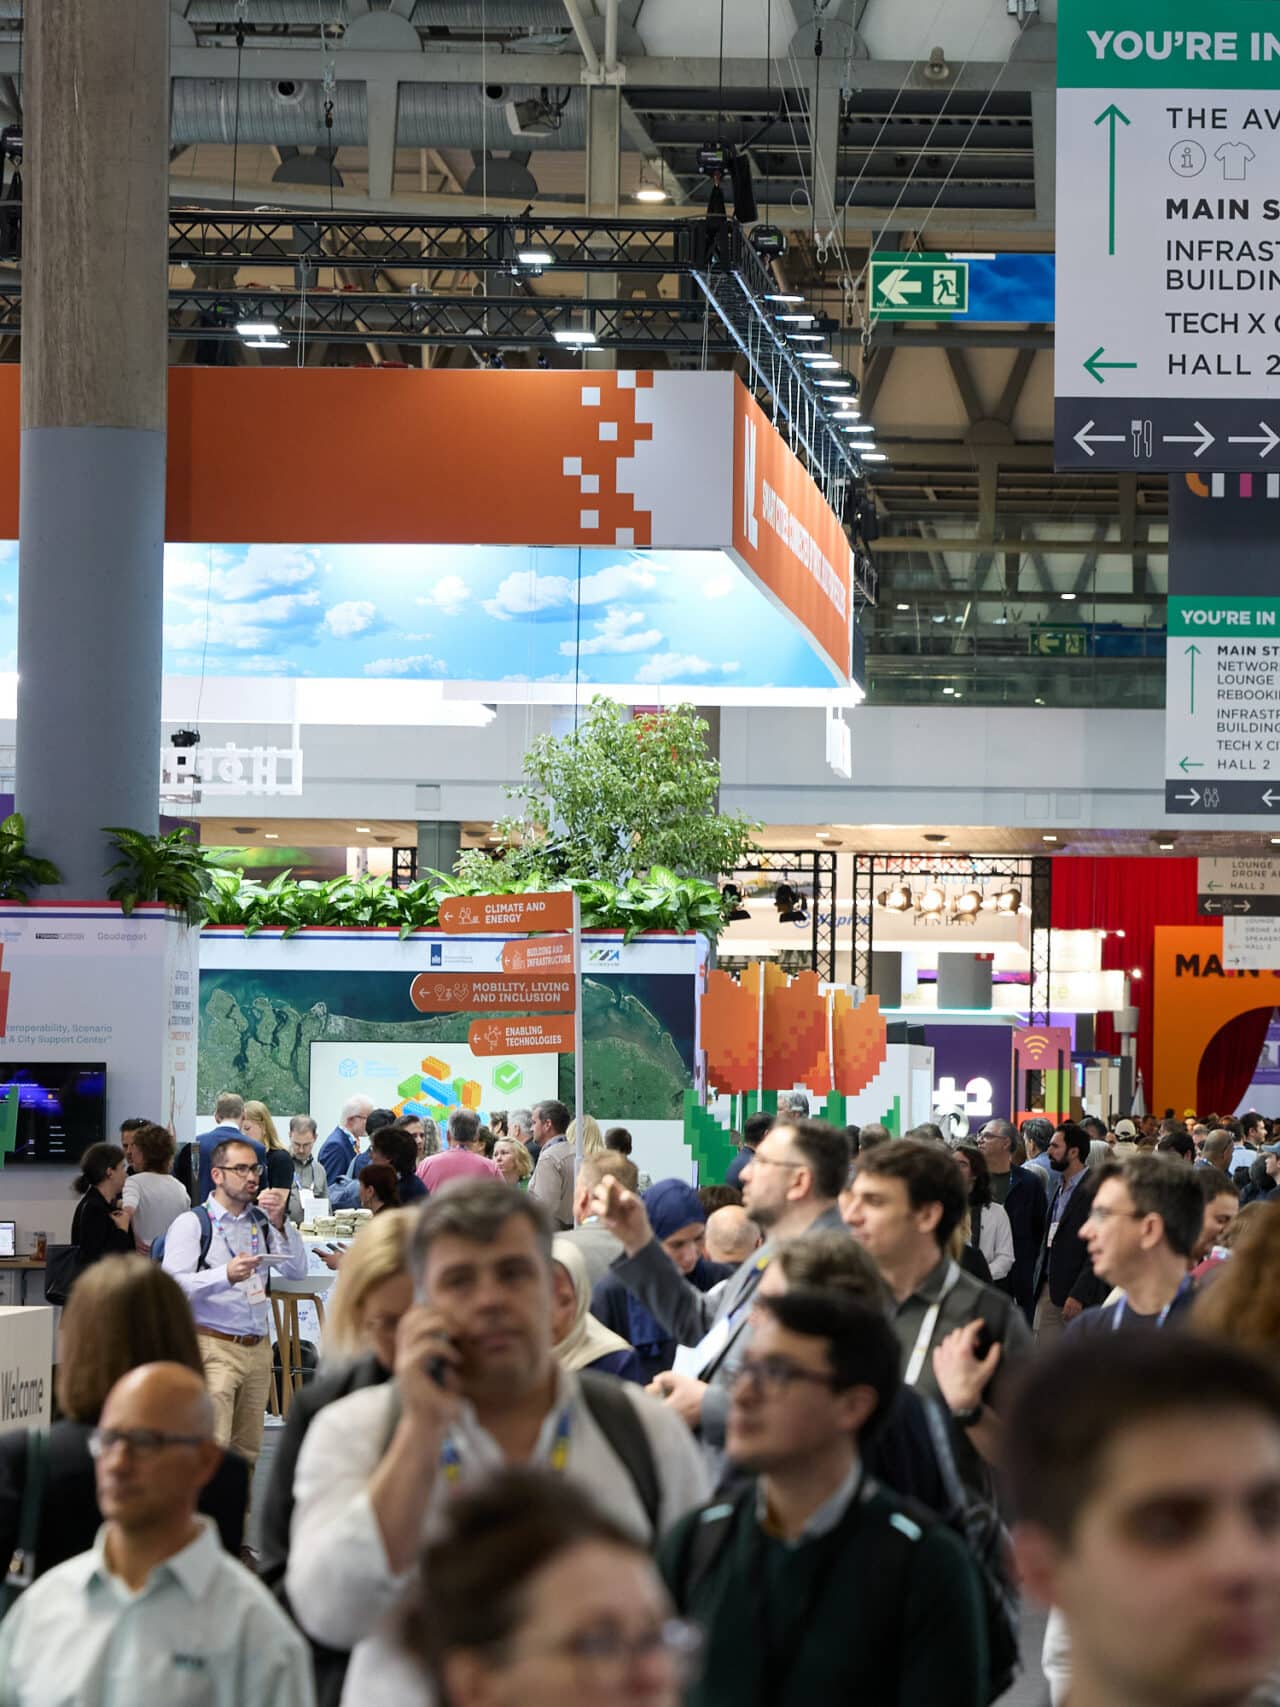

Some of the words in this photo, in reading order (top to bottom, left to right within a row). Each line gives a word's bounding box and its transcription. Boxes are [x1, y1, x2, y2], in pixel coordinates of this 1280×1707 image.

[1087, 30, 1238, 61] YOU'RE
[1166, 107, 1228, 130] THE
[1166, 197, 1250, 221] MAIN
[1166, 311, 1239, 335] TECH
[1248, 312, 1266, 335] X
[1168, 353, 1252, 376] HALL
[1256, 610, 1276, 625] IN
[1217, 645, 1257, 657] MAIN
[1217, 674, 1275, 686] LOUNGE
[1216, 740, 1251, 751] TECH
[1254, 740, 1264, 751] X
[1217, 759, 1257, 770] HALL
[1262, 759, 1271, 770] 2
[1231, 861, 1273, 869] LOUNGE
[1231, 870, 1268, 878] DRONE
[1229, 882, 1256, 890] HALL
[1259, 882, 1266, 890] 2
[484, 902, 524, 914] CLIMATE
[526, 901, 546, 912] AND
[485, 913, 522, 924] ENERGY
[1175, 955, 1258, 977] MA
[472, 982, 529, 993] MOBILITY,
[531, 982, 570, 992] LIVING
[472, 993, 496, 1003] AND
[499, 993, 561, 1003] INCLUSION
[505, 1025, 543, 1037] ENABLING
[505, 1037, 563, 1048] TECHNOLOGIES
[1, 1367, 43, 1421] Welcome
